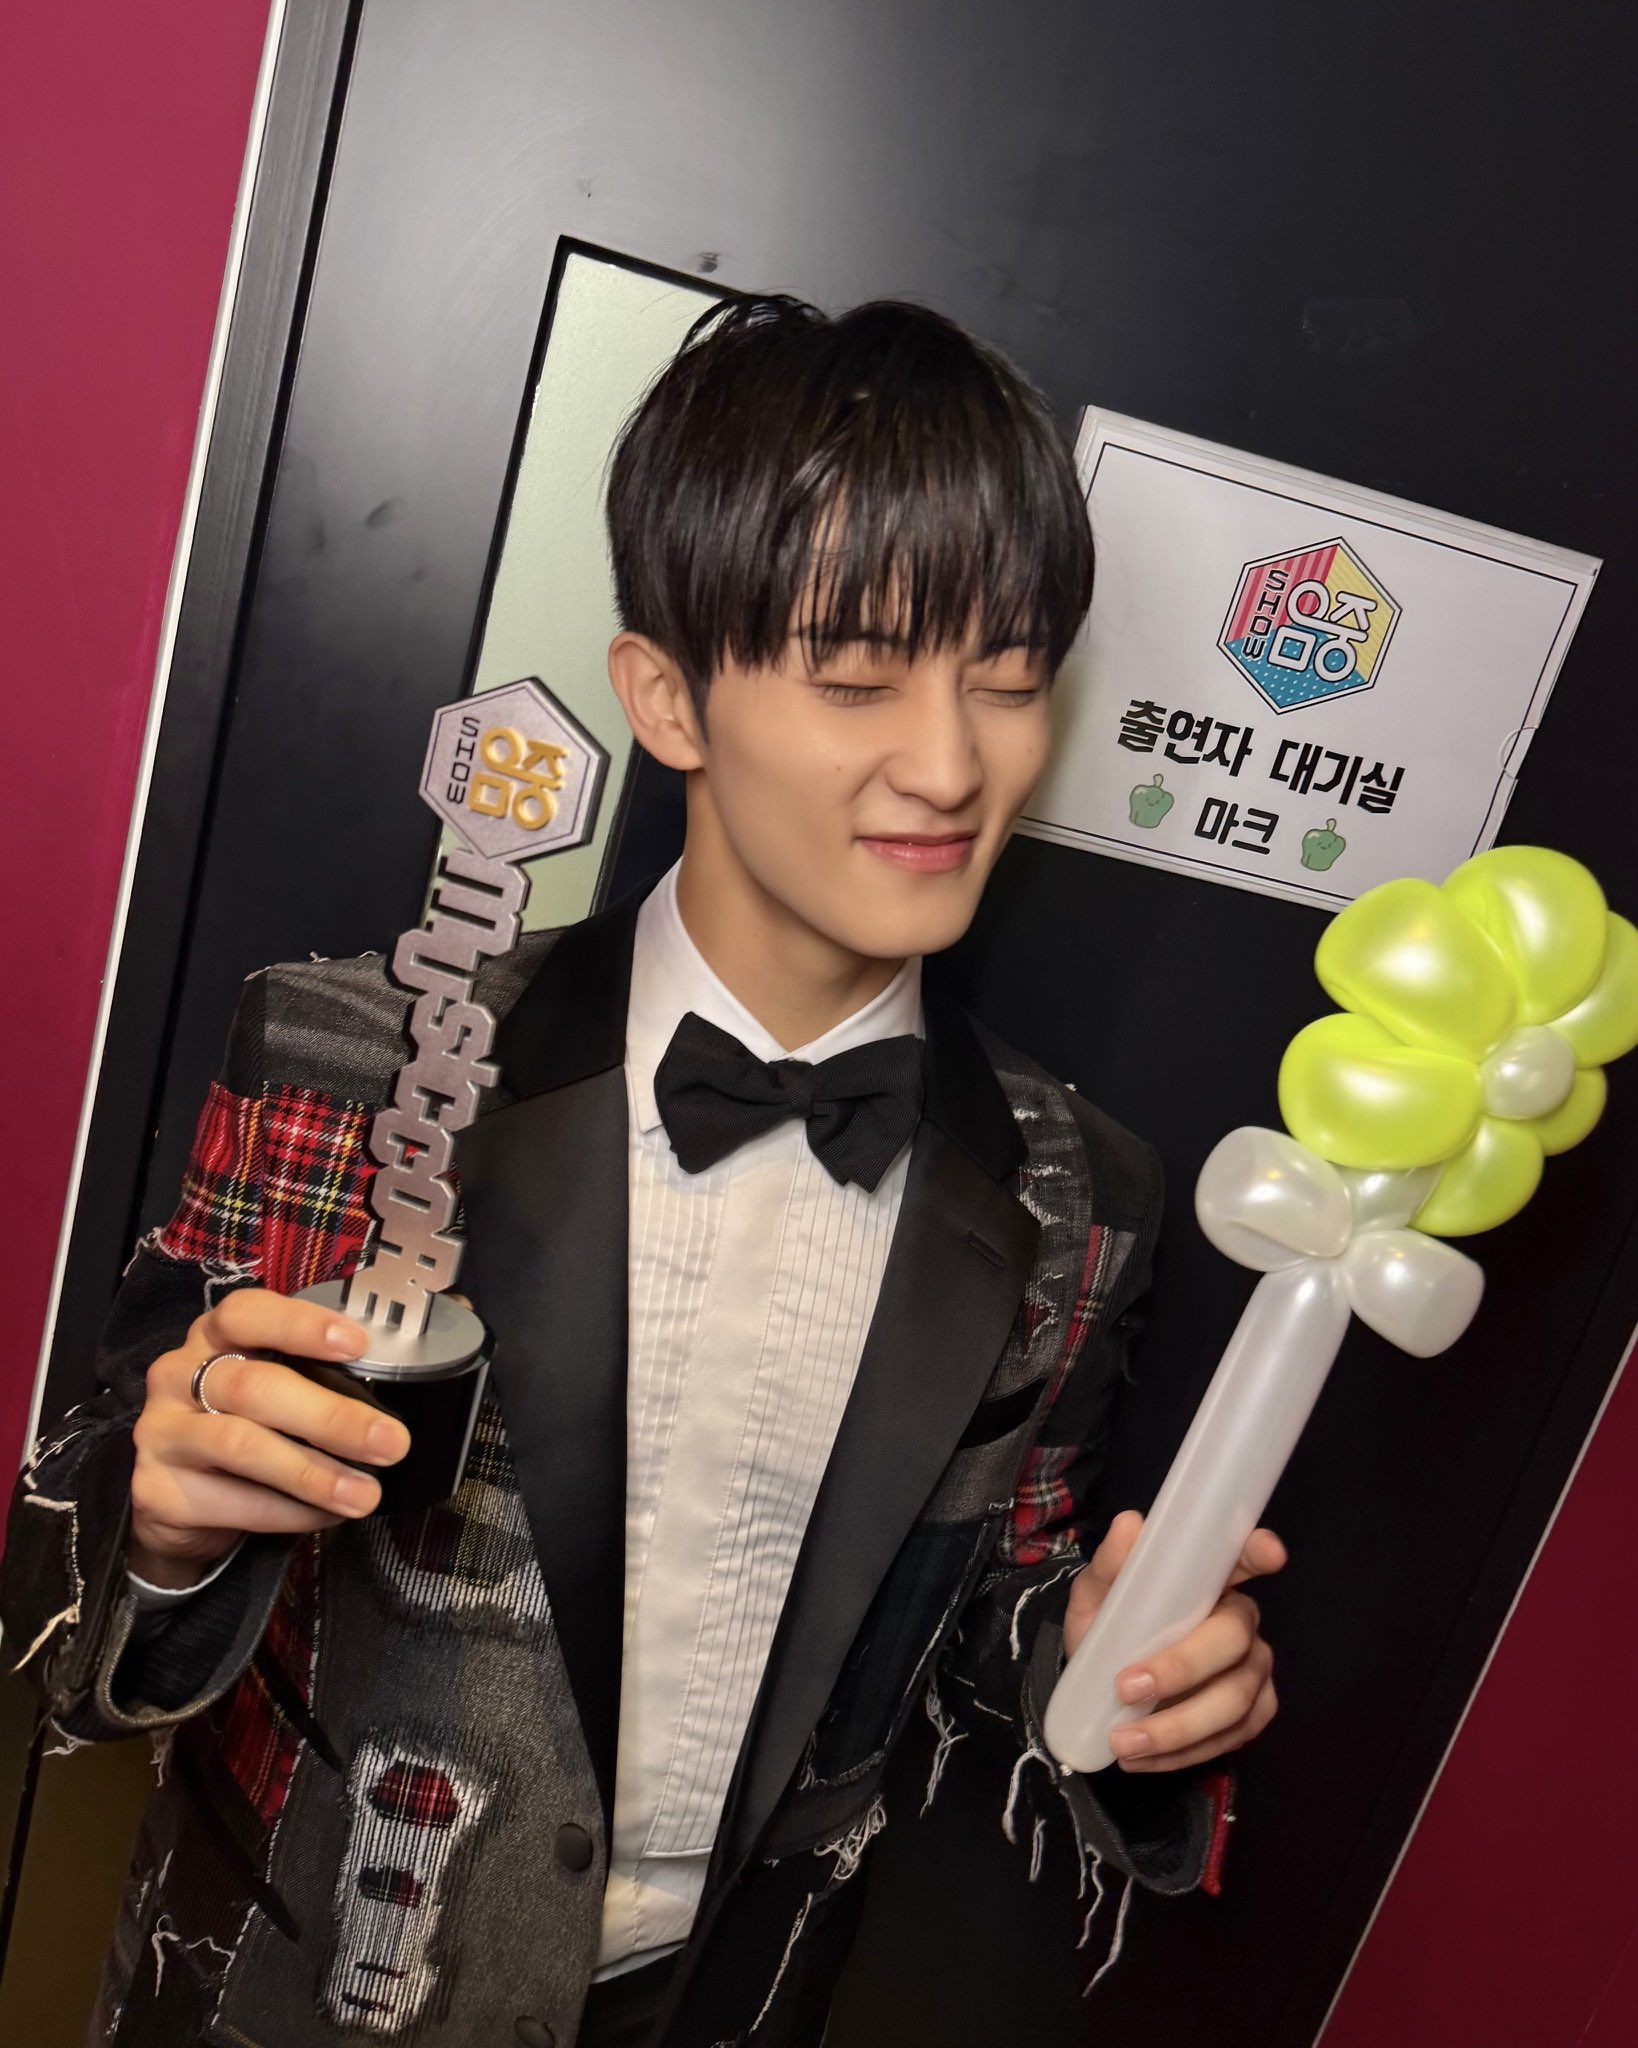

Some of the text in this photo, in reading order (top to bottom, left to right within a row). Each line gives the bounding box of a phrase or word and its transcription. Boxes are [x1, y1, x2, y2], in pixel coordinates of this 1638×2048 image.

[1242, 569, 1289, 659] SHOW
[447, 716, 480, 804] SHOW
[1117, 699, 1405, 814] 출연자 대기실
[1194, 797, 1280, 855] 마크
